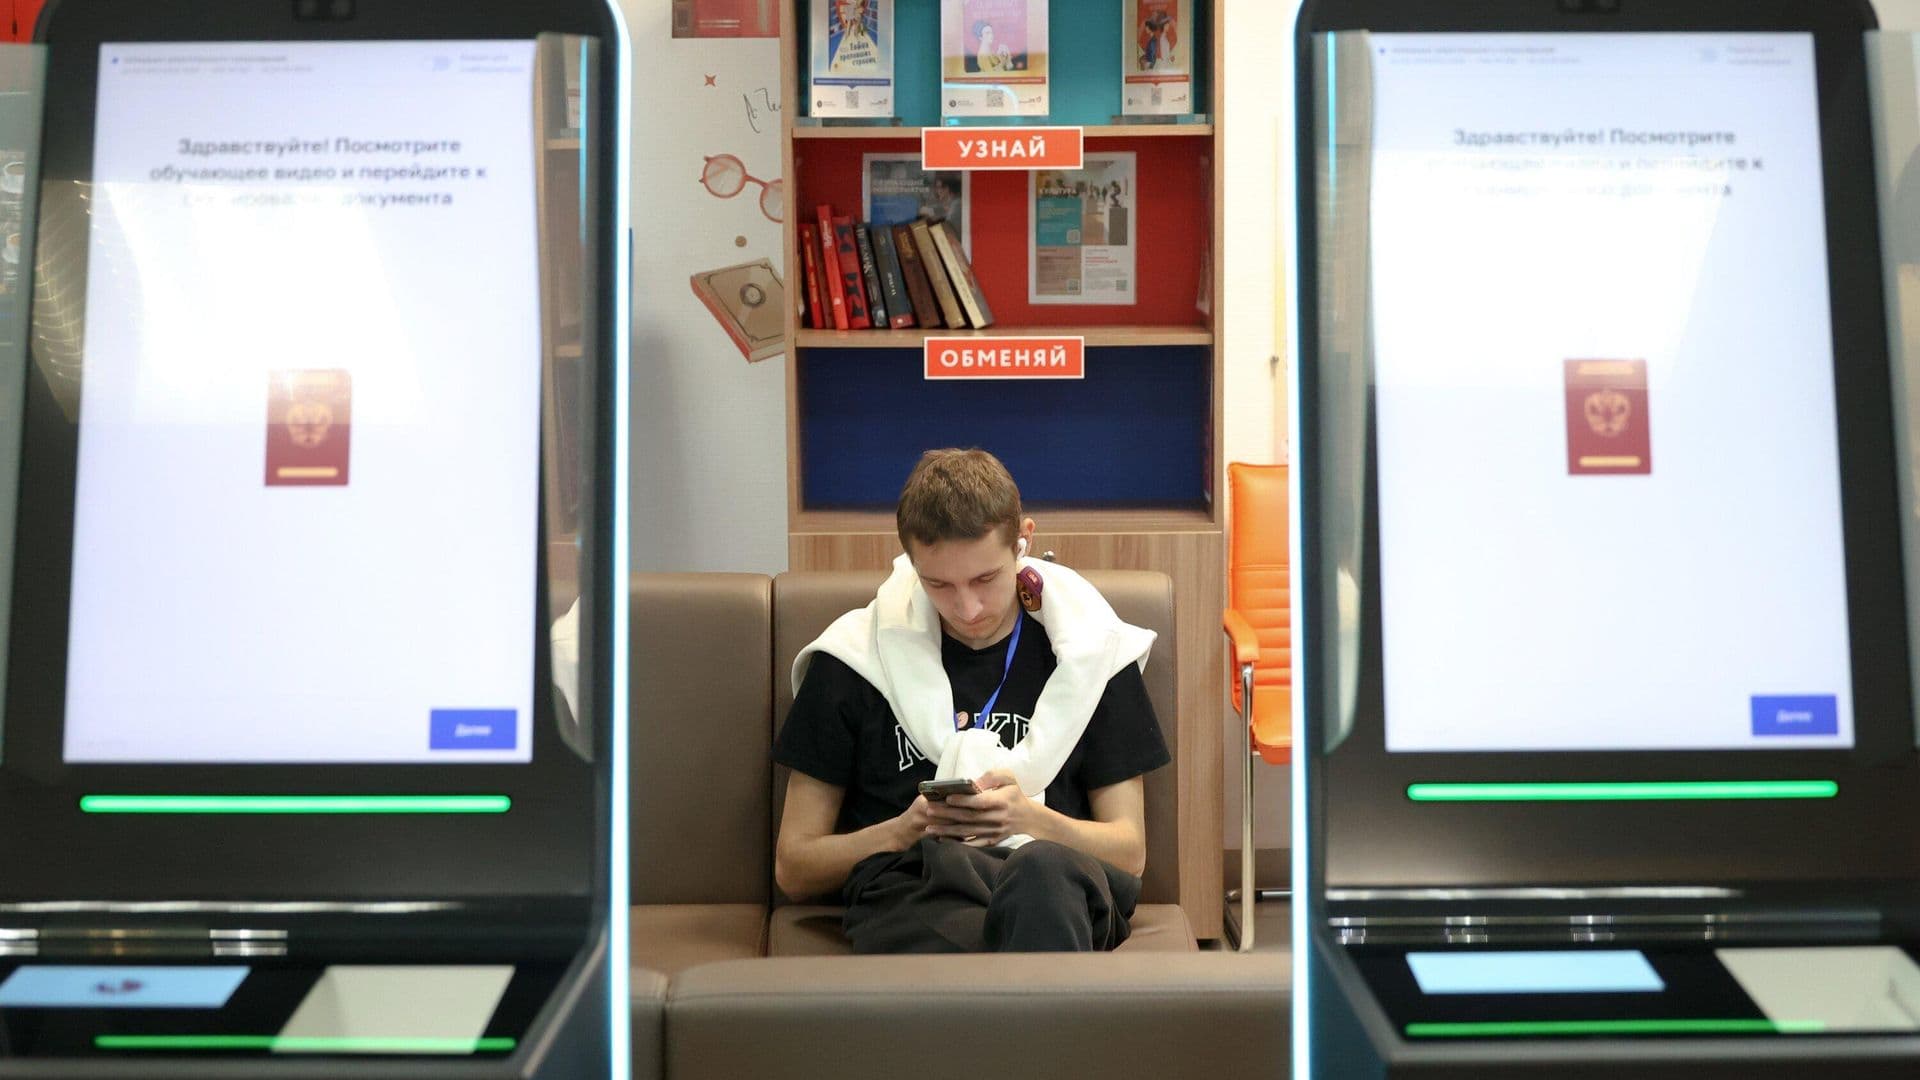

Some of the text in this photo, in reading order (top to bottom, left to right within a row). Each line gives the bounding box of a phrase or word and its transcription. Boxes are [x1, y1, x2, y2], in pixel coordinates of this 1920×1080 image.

[178, 137, 461, 157] Здравствуйте! Посмотрите
[958, 136, 1046, 159] УЗНАЙ
[1453, 128, 1736, 148] Здравствуйте! Посмотрите
[150, 164, 487, 182] обучающее видео и перейдите к
[940, 345, 1067, 368] ОБМЕНЯЙ
